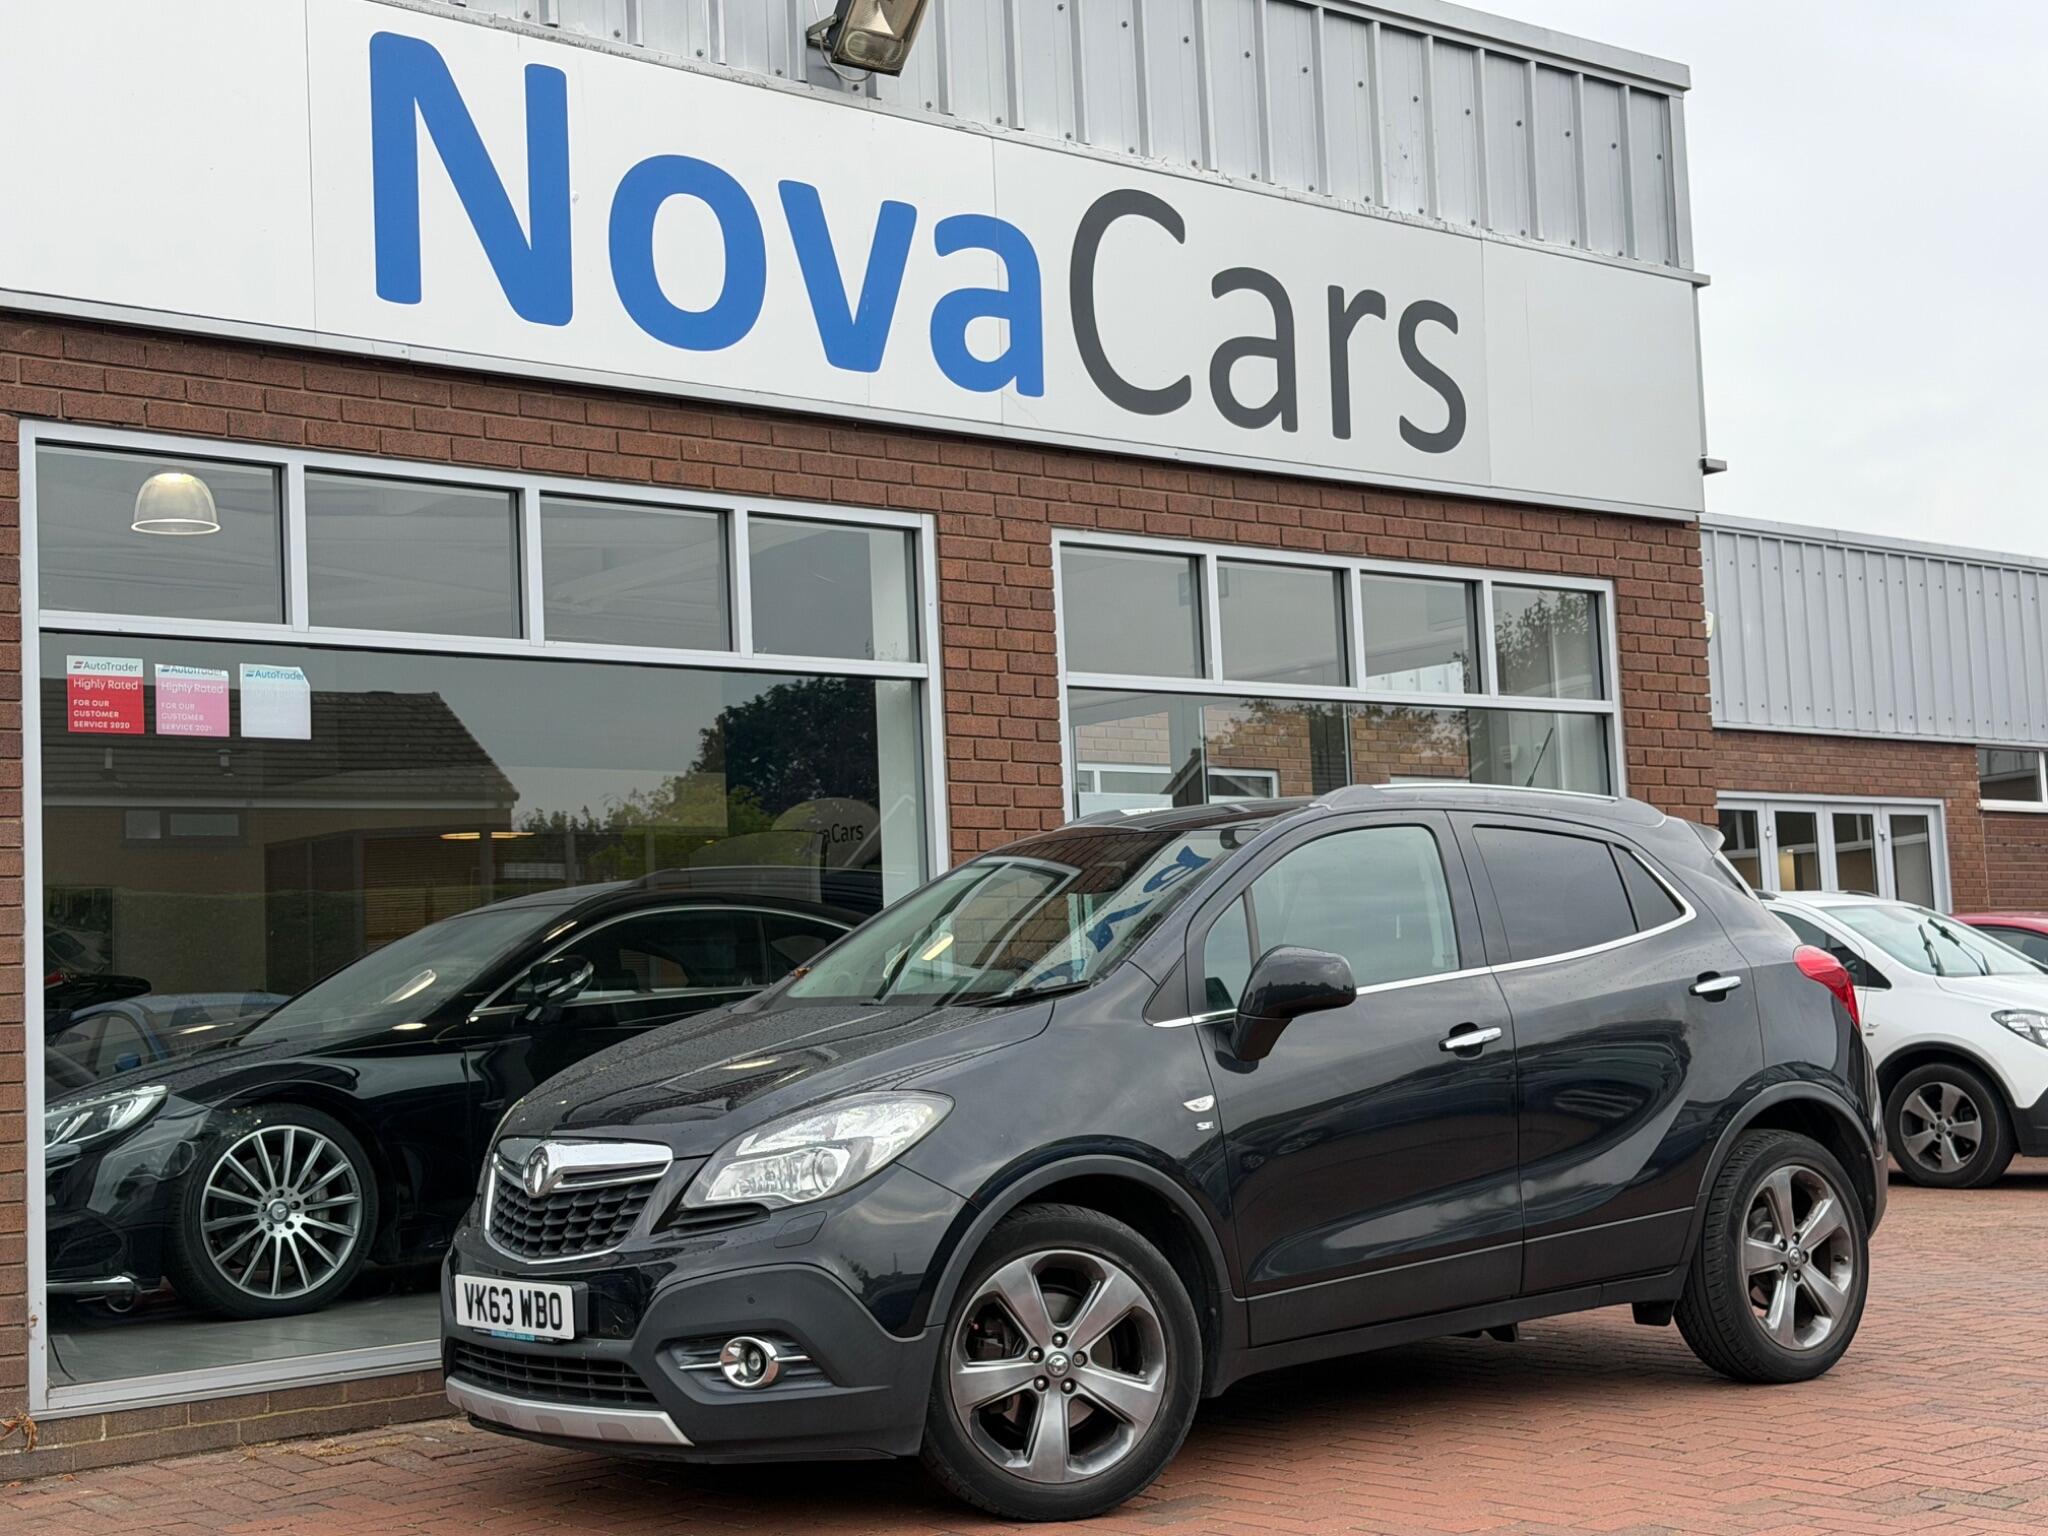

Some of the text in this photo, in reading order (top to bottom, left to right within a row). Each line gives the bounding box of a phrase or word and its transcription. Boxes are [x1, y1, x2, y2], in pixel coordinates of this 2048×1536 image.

[369, 31, 1467, 454] NovaCars
[84, 661, 138, 672] AutoTrader
[74, 679, 138, 691] Highly Rated
[161, 681, 224, 695] Highly Rated
[73, 699, 110, 708] FOR OUR
[73, 710, 119, 718] CUSTOMER
[73, 720, 130, 729] SERVICE 2020
[464, 1282, 563, 1331] VK63 WBO
